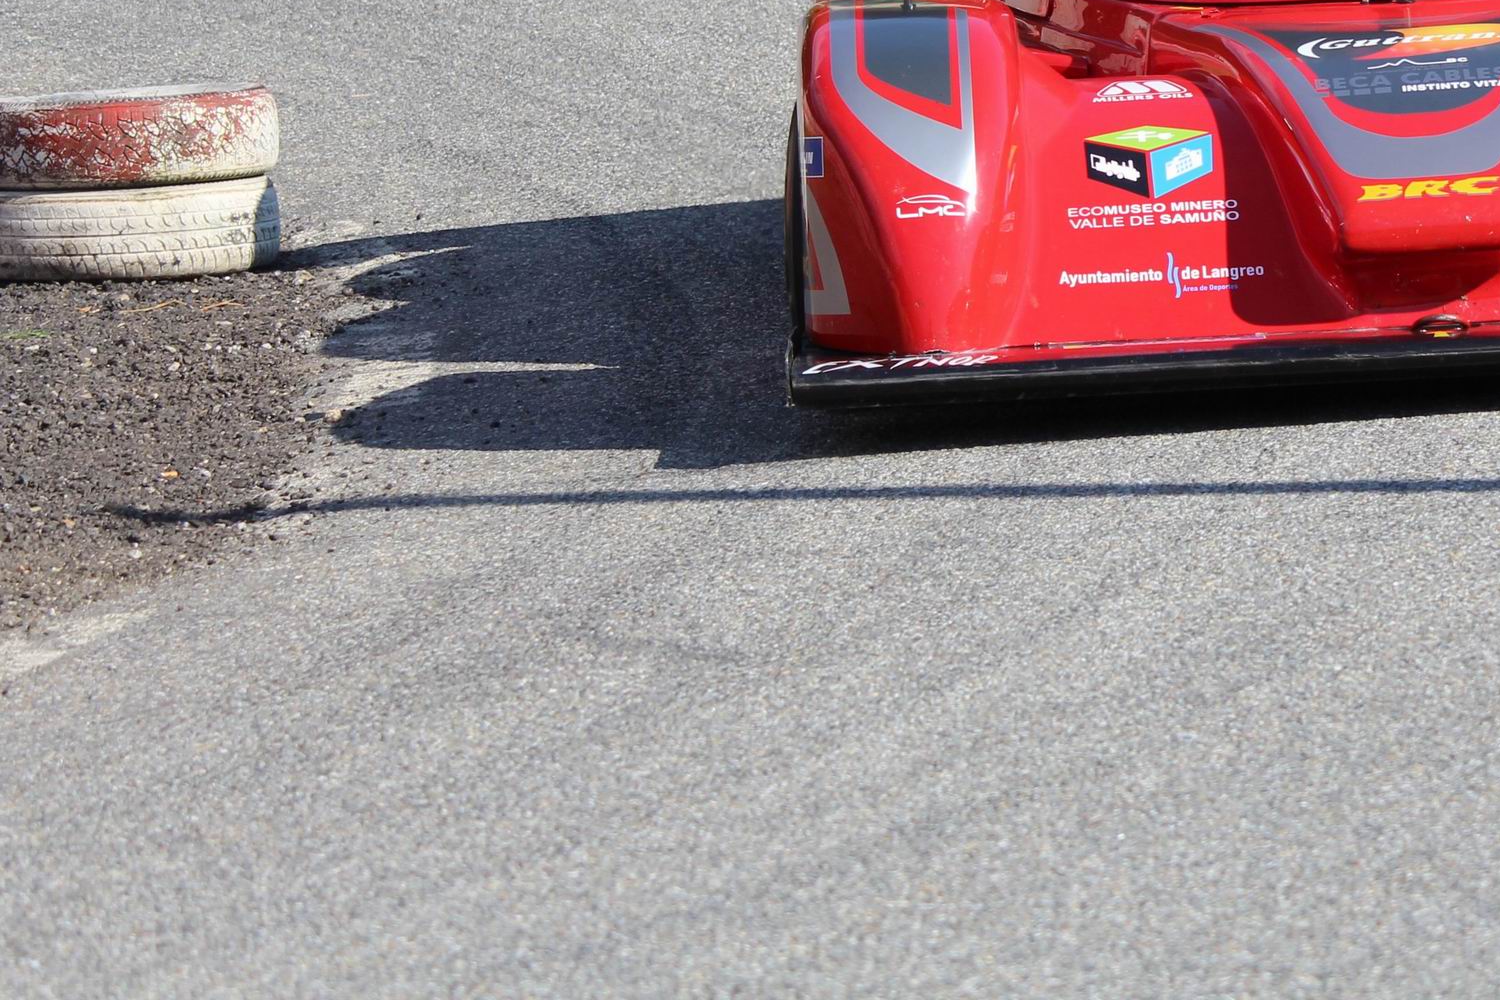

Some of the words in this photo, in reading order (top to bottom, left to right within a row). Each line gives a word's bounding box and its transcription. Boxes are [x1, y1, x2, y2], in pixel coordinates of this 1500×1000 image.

[1313, 74, 1393, 91] BECA
[1401, 81, 1471, 93] INSTINTO
[1092, 93, 1155, 103] MILLERS
[1158, 91, 1194, 99] OILS
[1357, 175, 1500, 202] BRC
[1067, 202, 1166, 218] ECOMUSEO
[1170, 199, 1238, 212] MINERO
[1069, 215, 1125, 229] VALLE
[1129, 215, 1155, 227] DE
[1159, 208, 1240, 225] SAMUÑO
[1059, 268, 1163, 288] Ayuntamiento
[1181, 265, 1200, 280] de
[1201, 264, 1265, 281] Langreo
